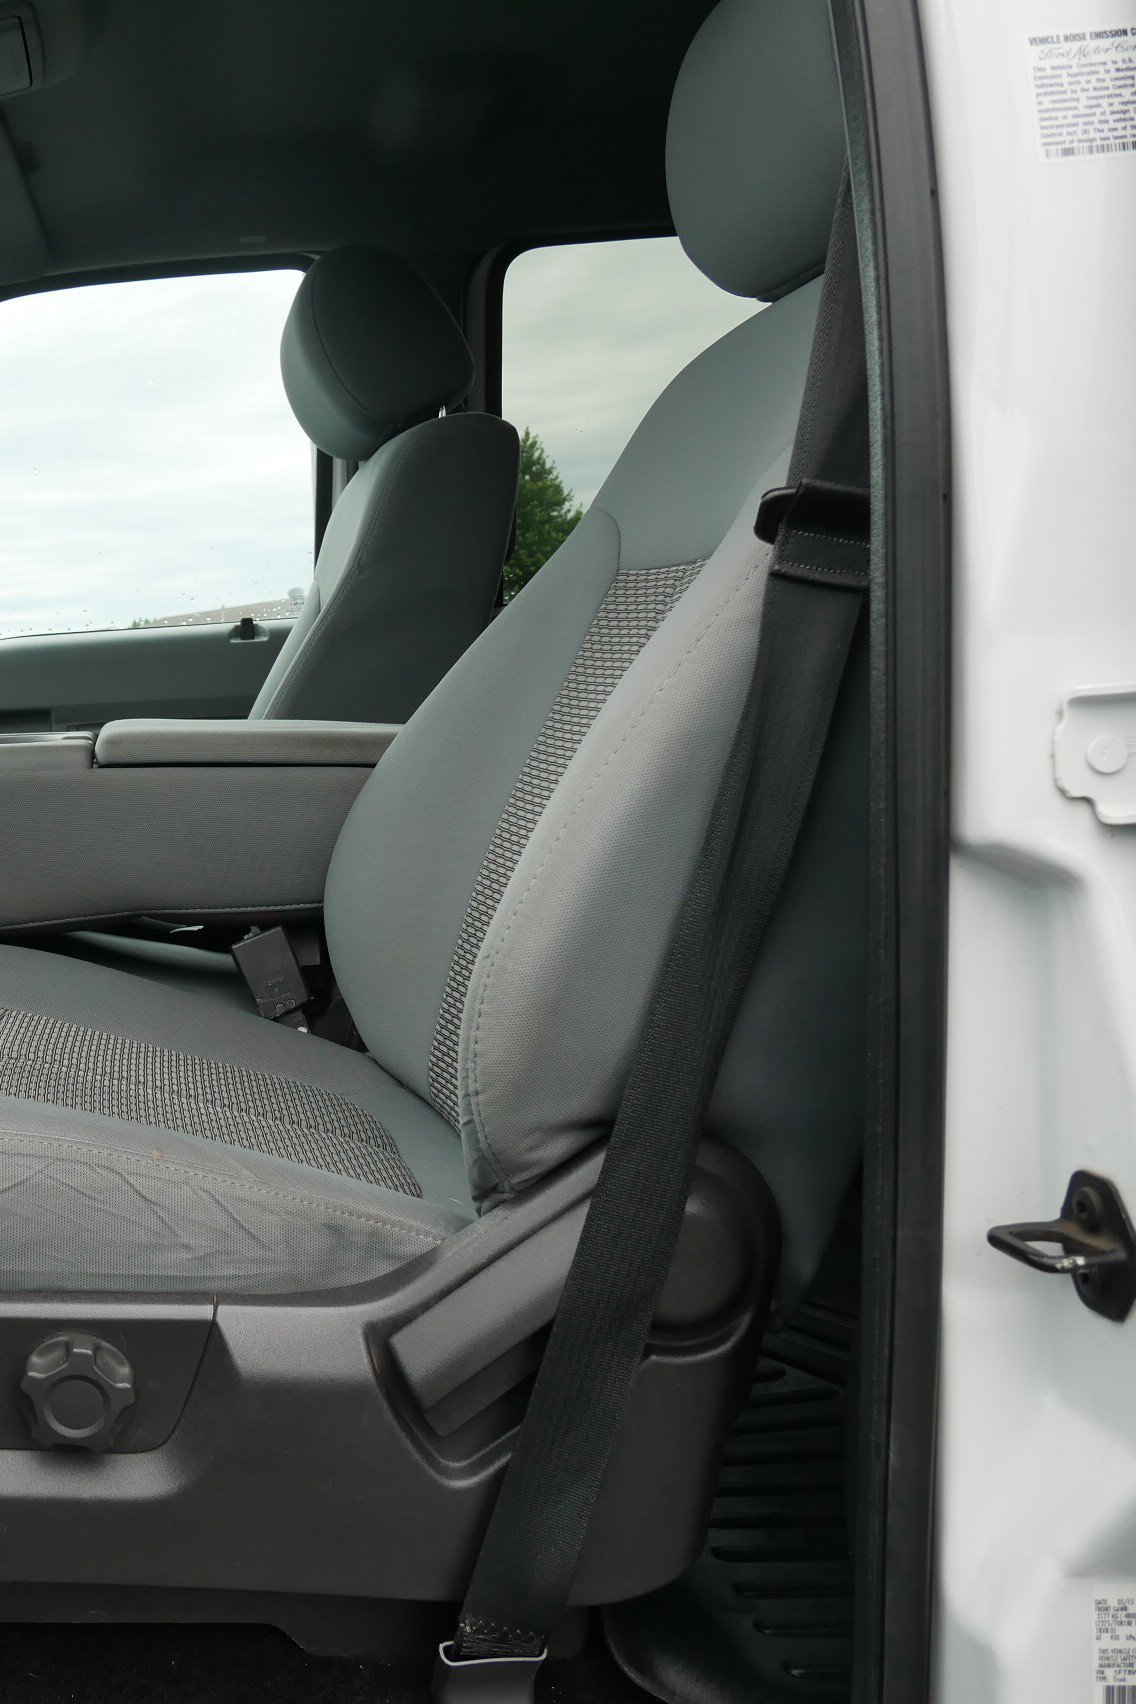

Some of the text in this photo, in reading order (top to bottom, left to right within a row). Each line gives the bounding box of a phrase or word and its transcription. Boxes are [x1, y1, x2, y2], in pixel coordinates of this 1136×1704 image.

[1028, 34, 1061, 46] VEHICLE
[1063, 32, 1087, 43] NOISE
[1089, 28, 1128, 40] EMISSION
